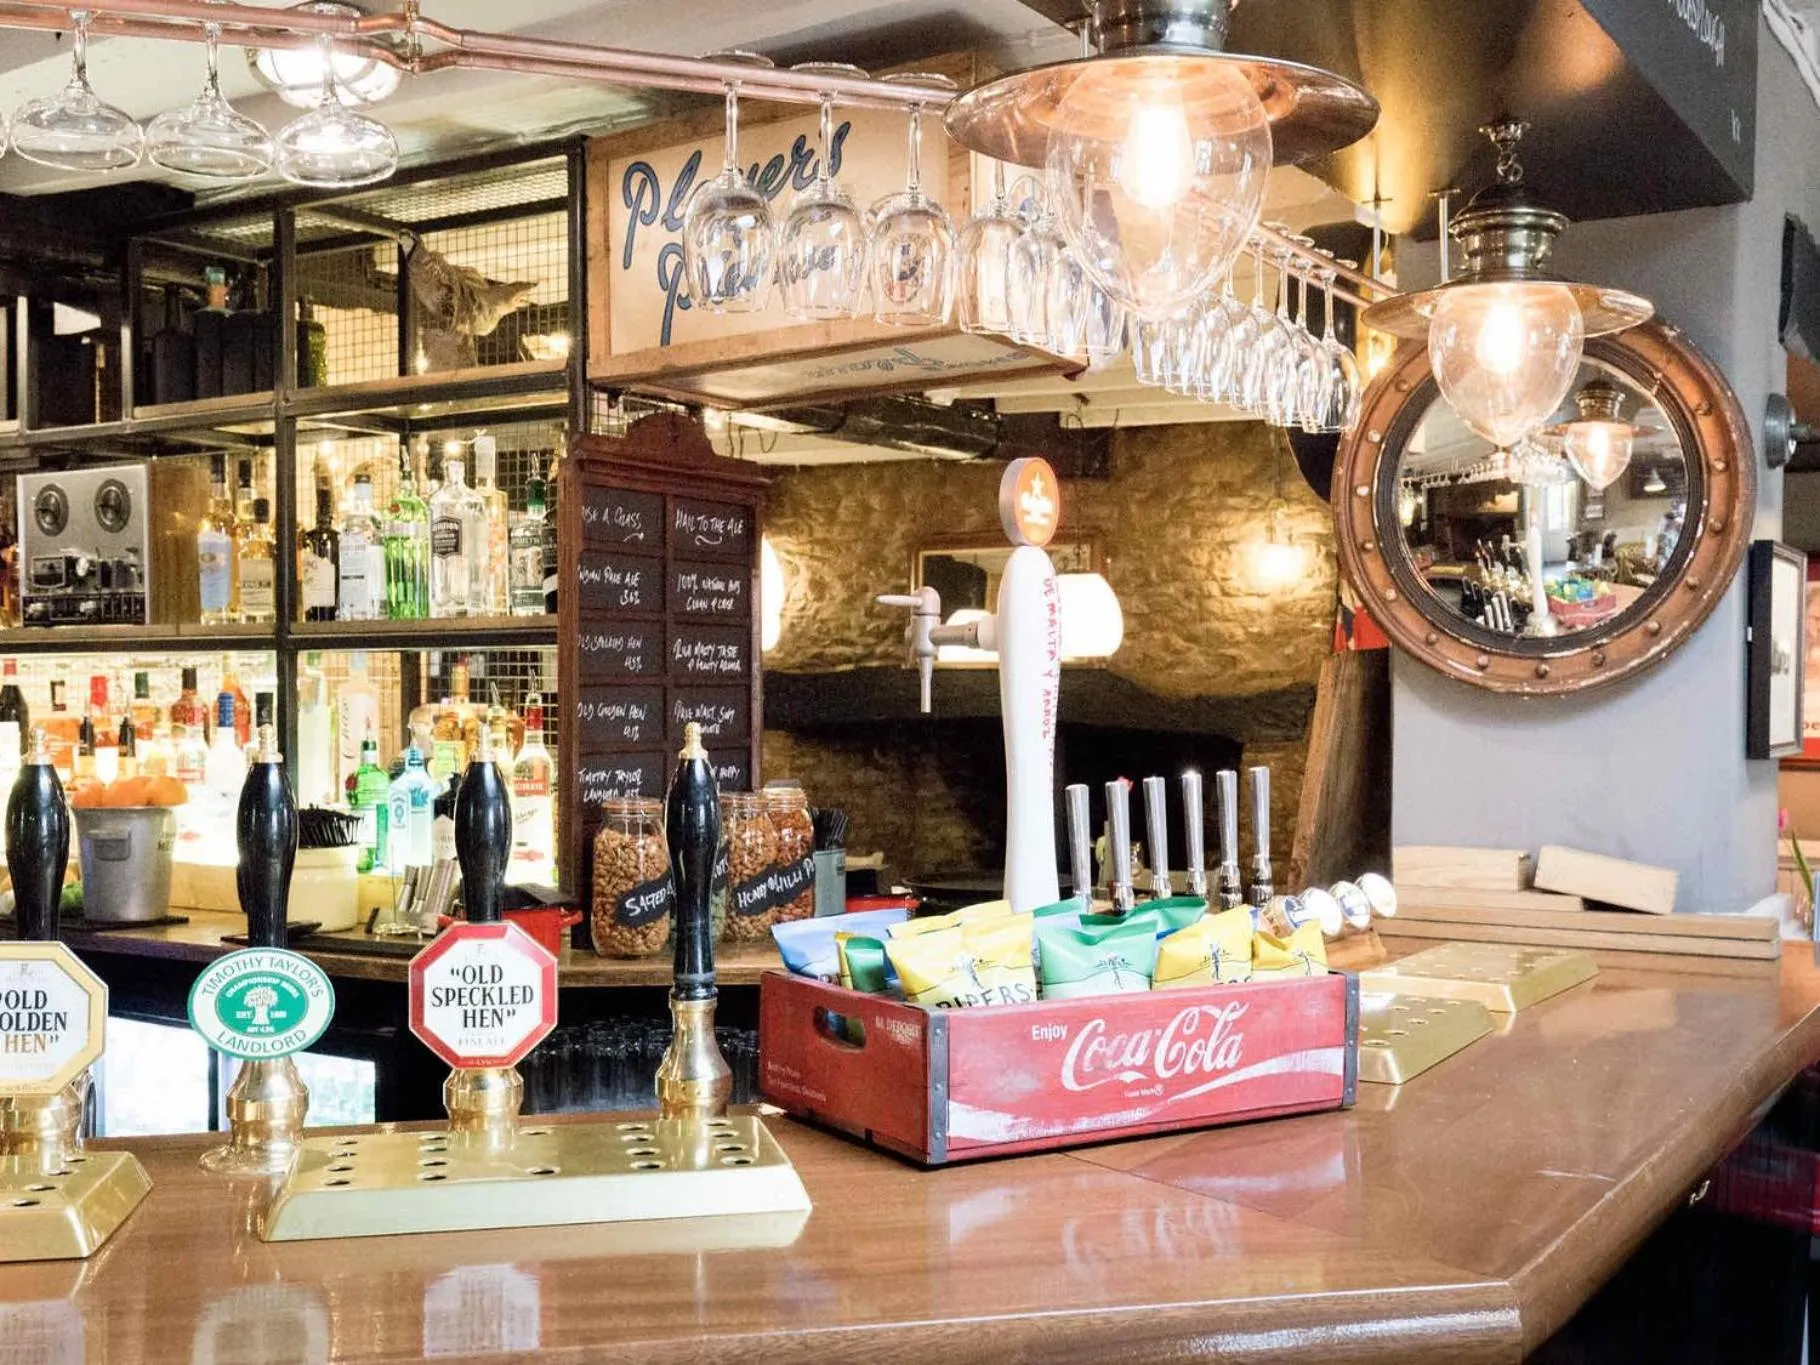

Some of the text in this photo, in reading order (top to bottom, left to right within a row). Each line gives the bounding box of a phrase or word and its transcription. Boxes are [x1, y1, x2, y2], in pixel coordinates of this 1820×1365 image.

[202, 956, 324, 998] TIMOTHY TAYLOR'S
[431, 985, 534, 1008] SPECKLED
[0, 1012, 67, 1032] OLDEN
[1031, 1024, 1069, 1042] Enjoy
[217, 1029, 307, 1054] LANDLORD
[1061, 1001, 1250, 1092] Coca-Cola
